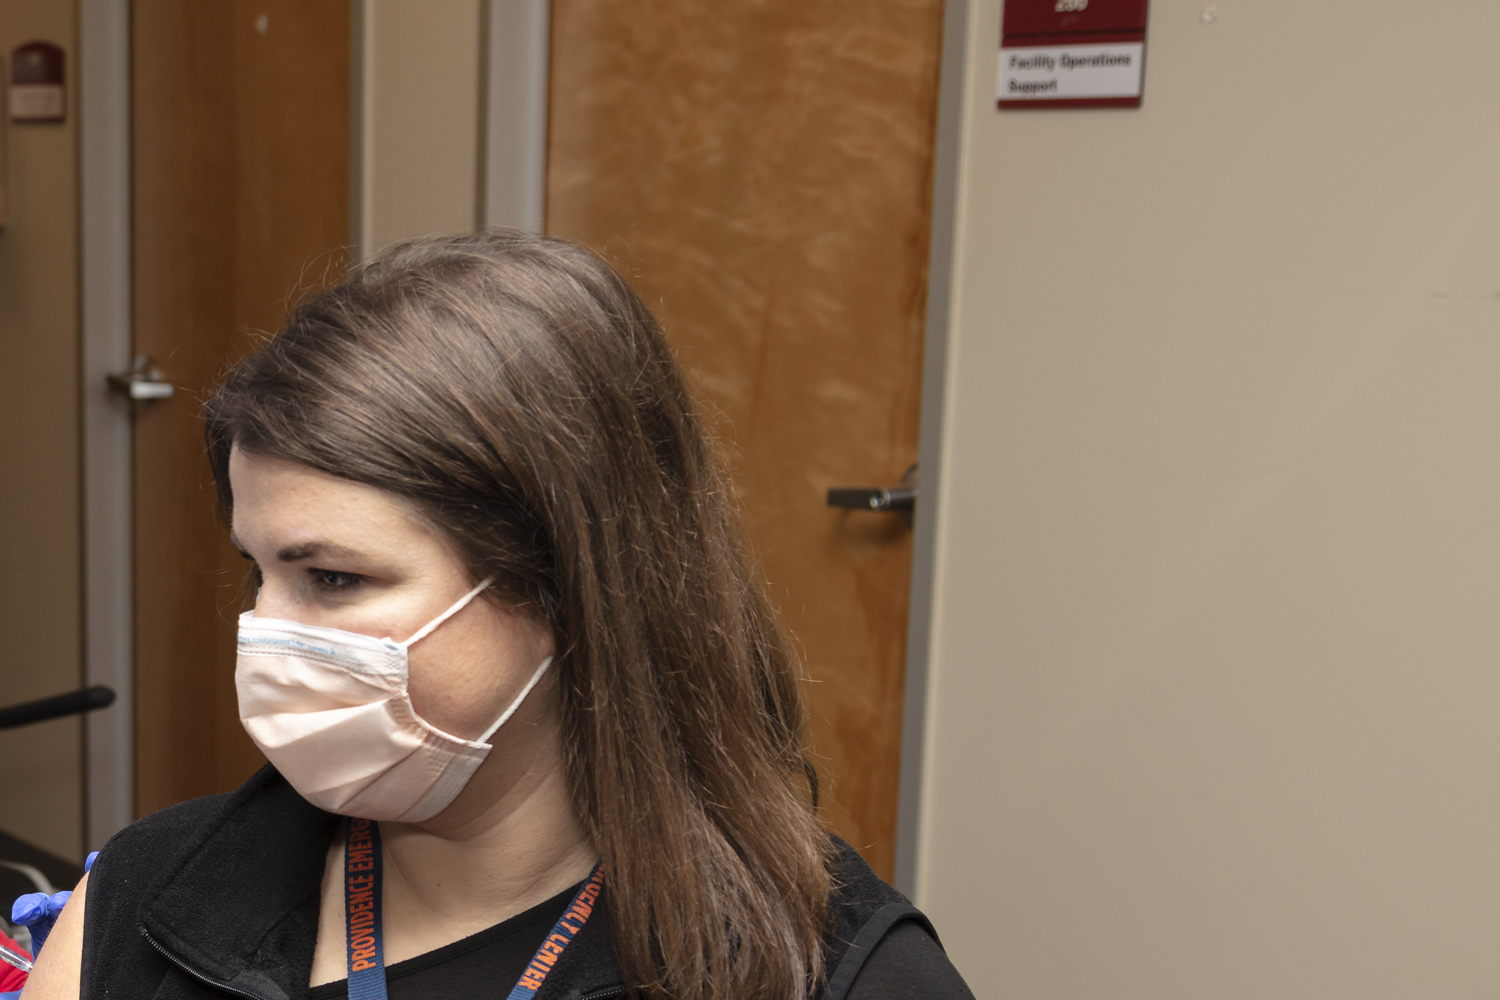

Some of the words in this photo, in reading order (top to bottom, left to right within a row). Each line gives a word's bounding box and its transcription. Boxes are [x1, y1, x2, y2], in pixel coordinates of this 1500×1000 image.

[1008, 54, 1057, 72] Facility
[1059, 51, 1132, 71] Operations
[1007, 78, 1058, 95] Support
[348, 818, 374, 873] EMERG
[349, 874, 377, 972] PROVIDENCE
